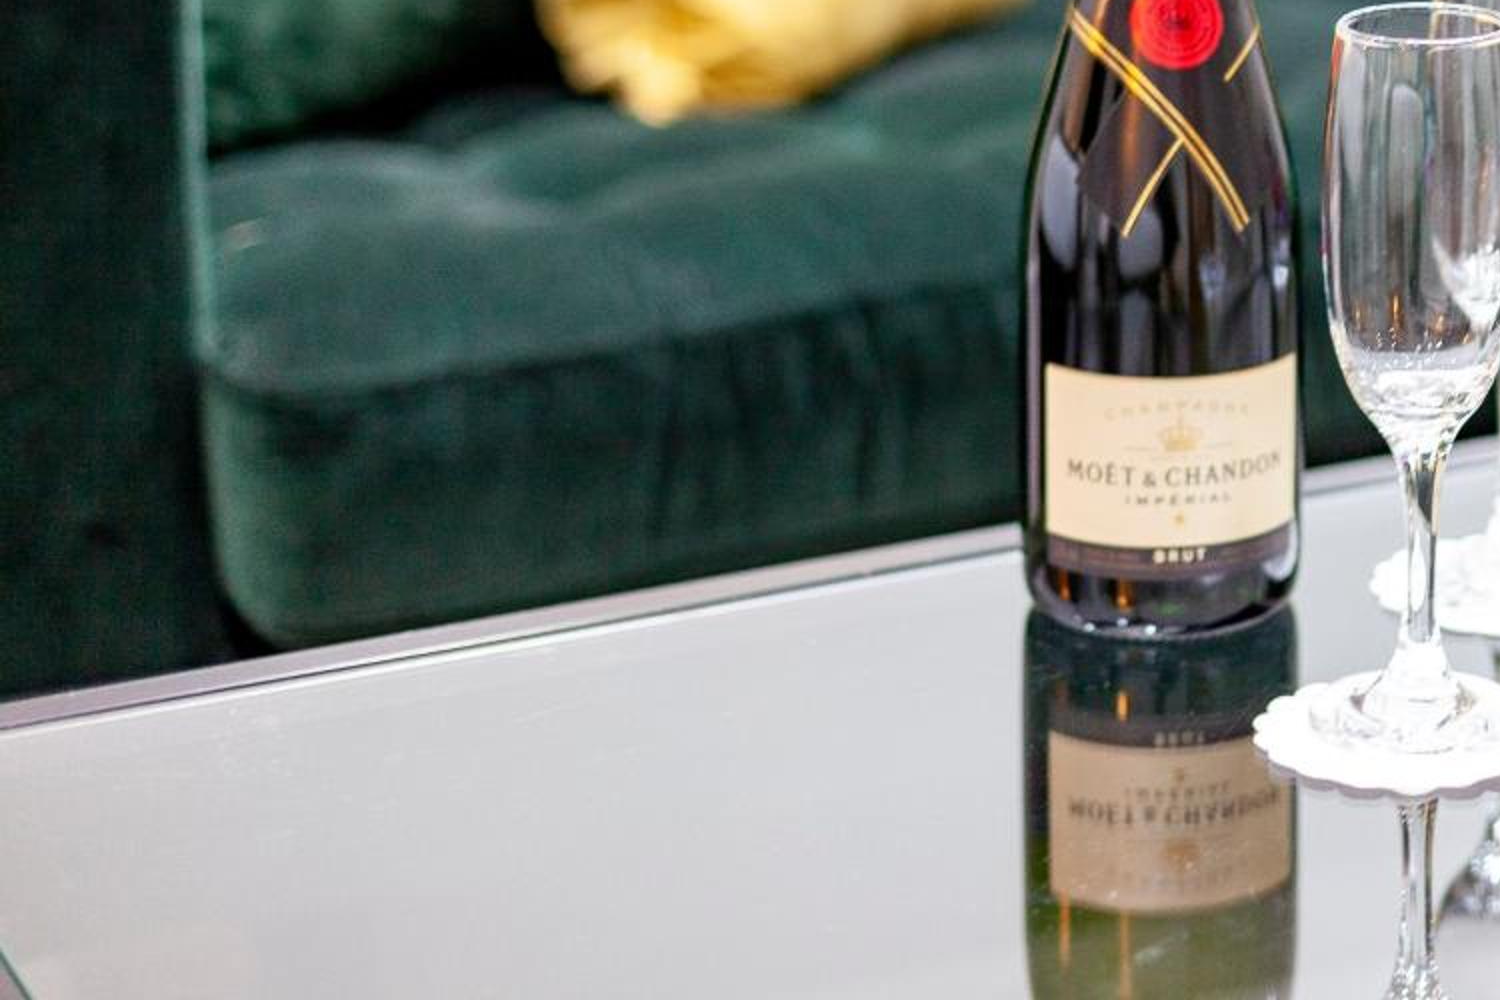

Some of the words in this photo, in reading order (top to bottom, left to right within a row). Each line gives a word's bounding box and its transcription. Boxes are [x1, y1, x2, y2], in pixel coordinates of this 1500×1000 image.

[1142, 472, 1157, 488] &
[1164, 450, 1281, 488] CHANDON
[1153, 547, 1206, 563] BRUT
